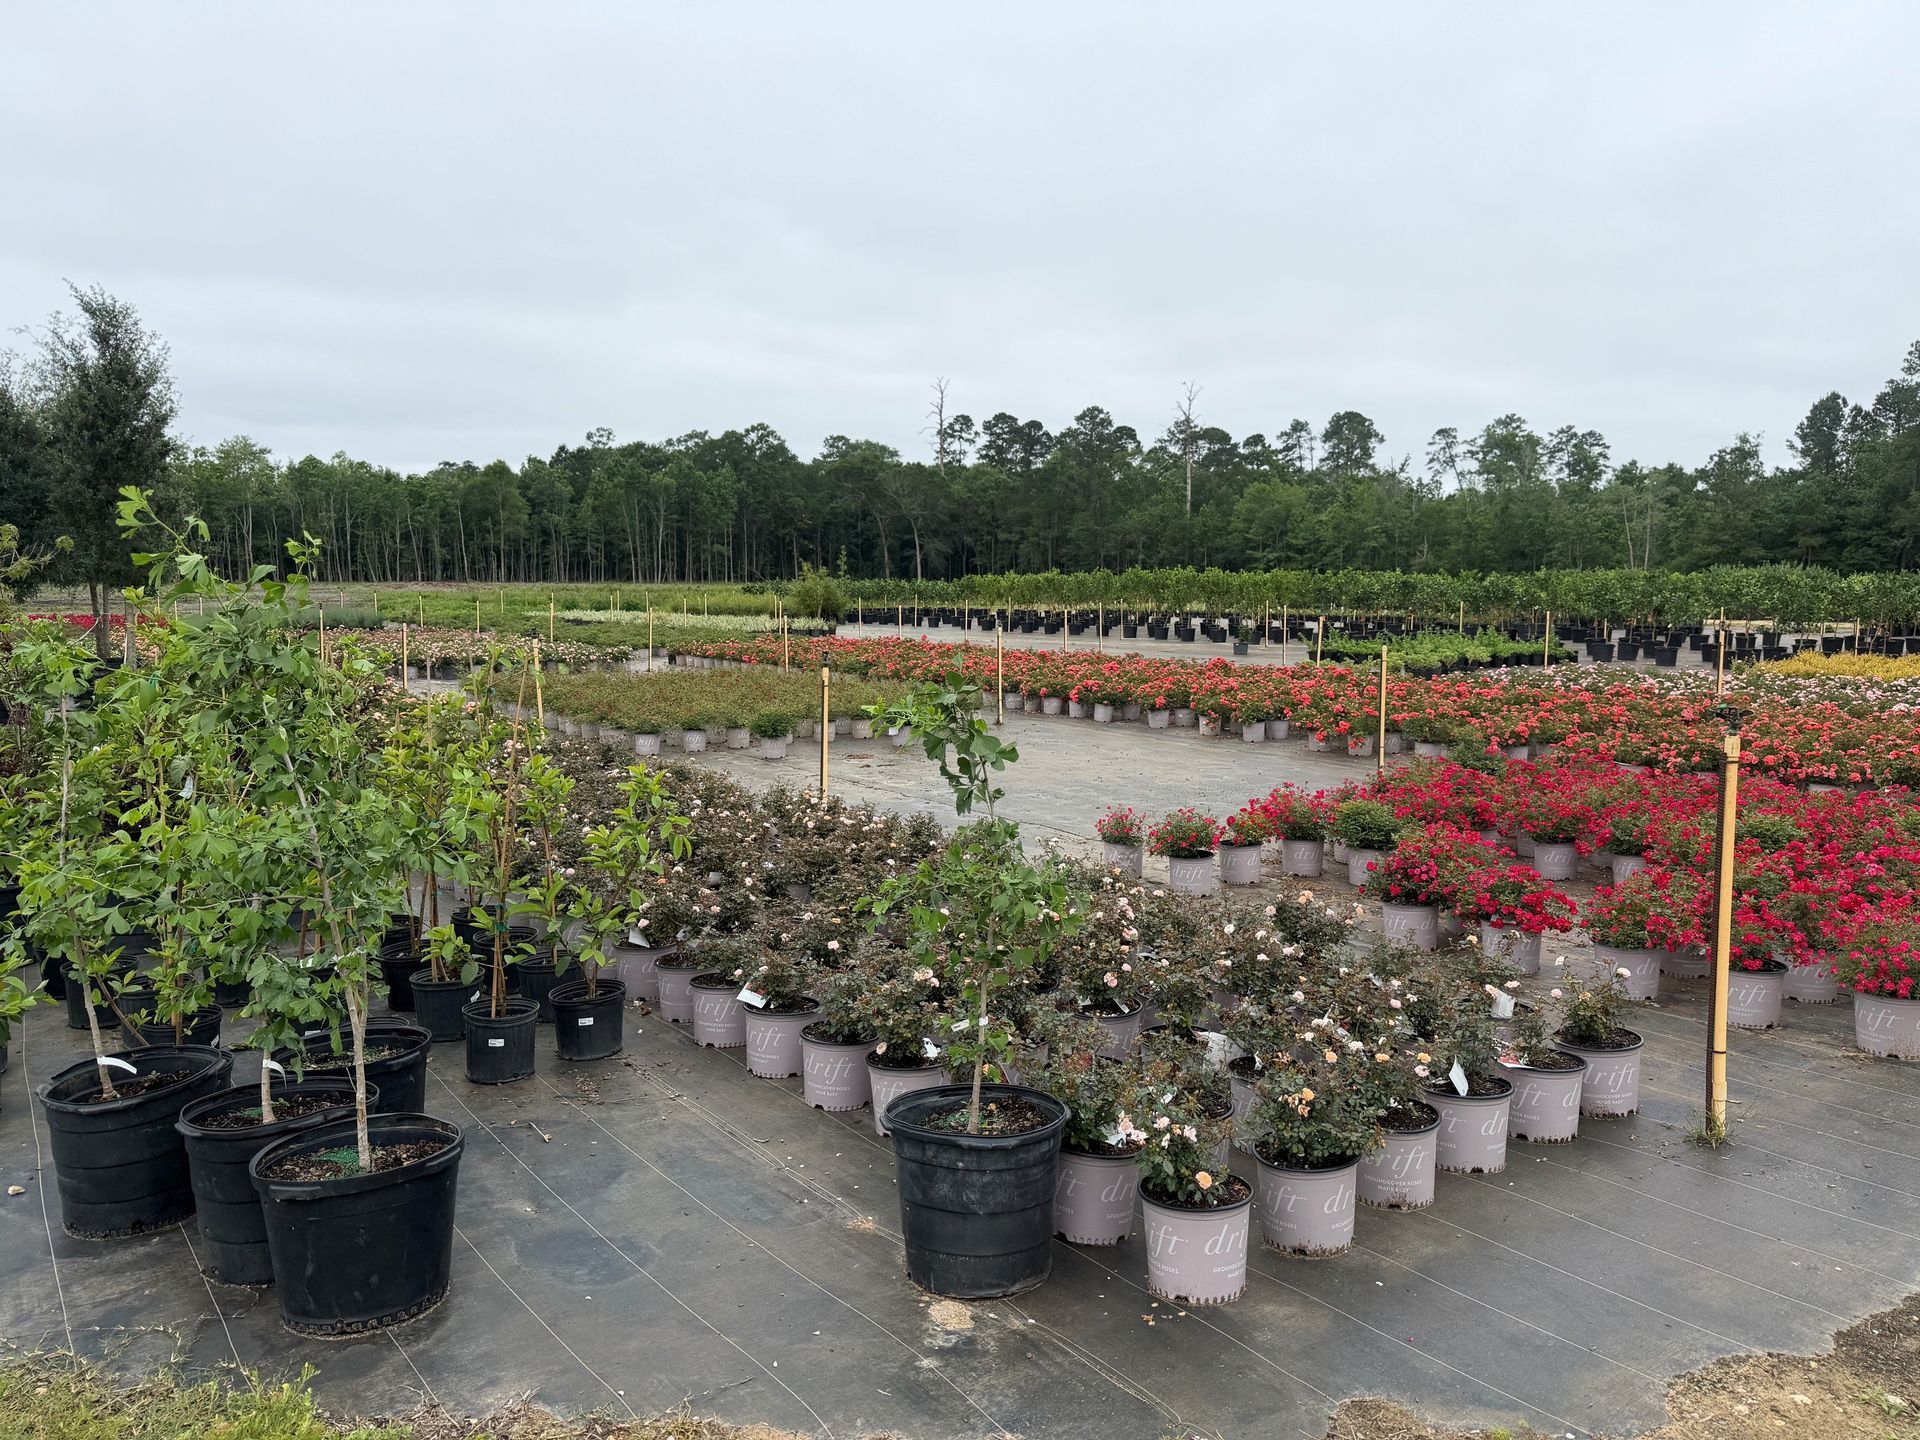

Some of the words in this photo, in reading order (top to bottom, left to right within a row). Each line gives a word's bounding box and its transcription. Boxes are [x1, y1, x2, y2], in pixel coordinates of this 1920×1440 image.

[1173, 865, 1204, 882] drift
[695, 995, 738, 1022] drift
[1728, 984, 1770, 1007] rift
[805, 1053, 857, 1084] drift
[1368, 1145, 1431, 1179] rift
[1149, 1221, 1185, 1258] ift
